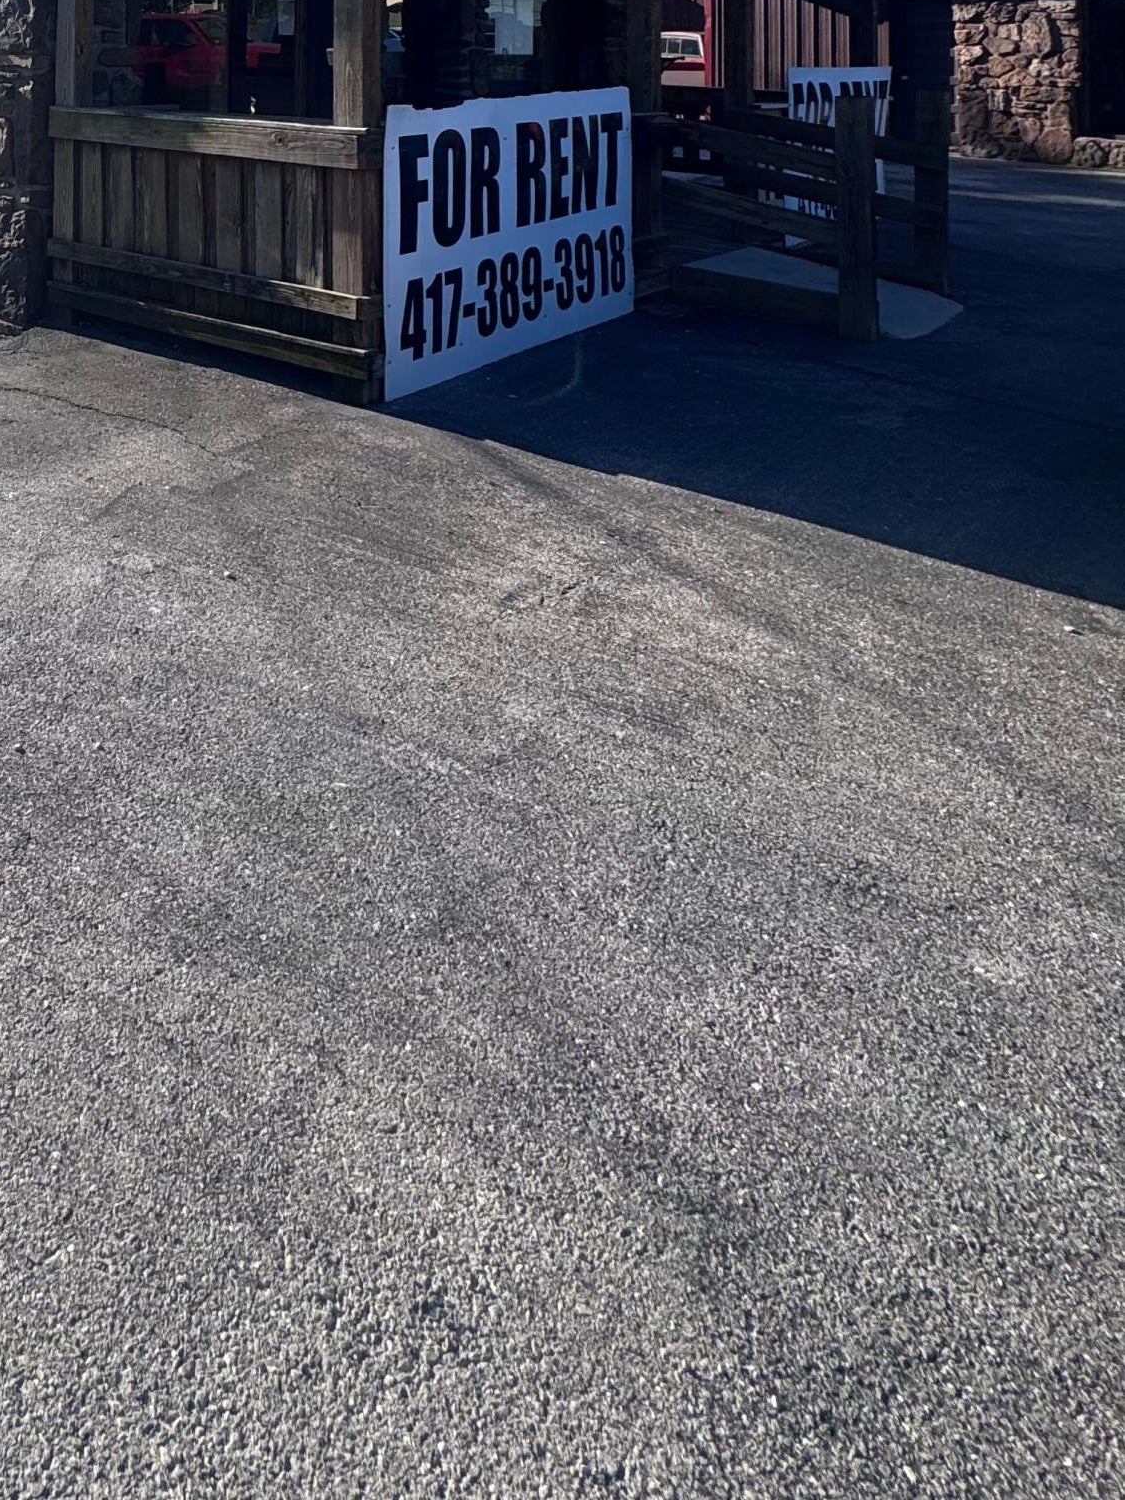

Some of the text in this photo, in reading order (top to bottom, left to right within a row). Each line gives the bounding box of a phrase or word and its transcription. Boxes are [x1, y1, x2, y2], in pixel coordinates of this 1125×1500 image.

[398, 111, 624, 256] FOR RENT
[399, 224, 626, 362] 417-389-3918
